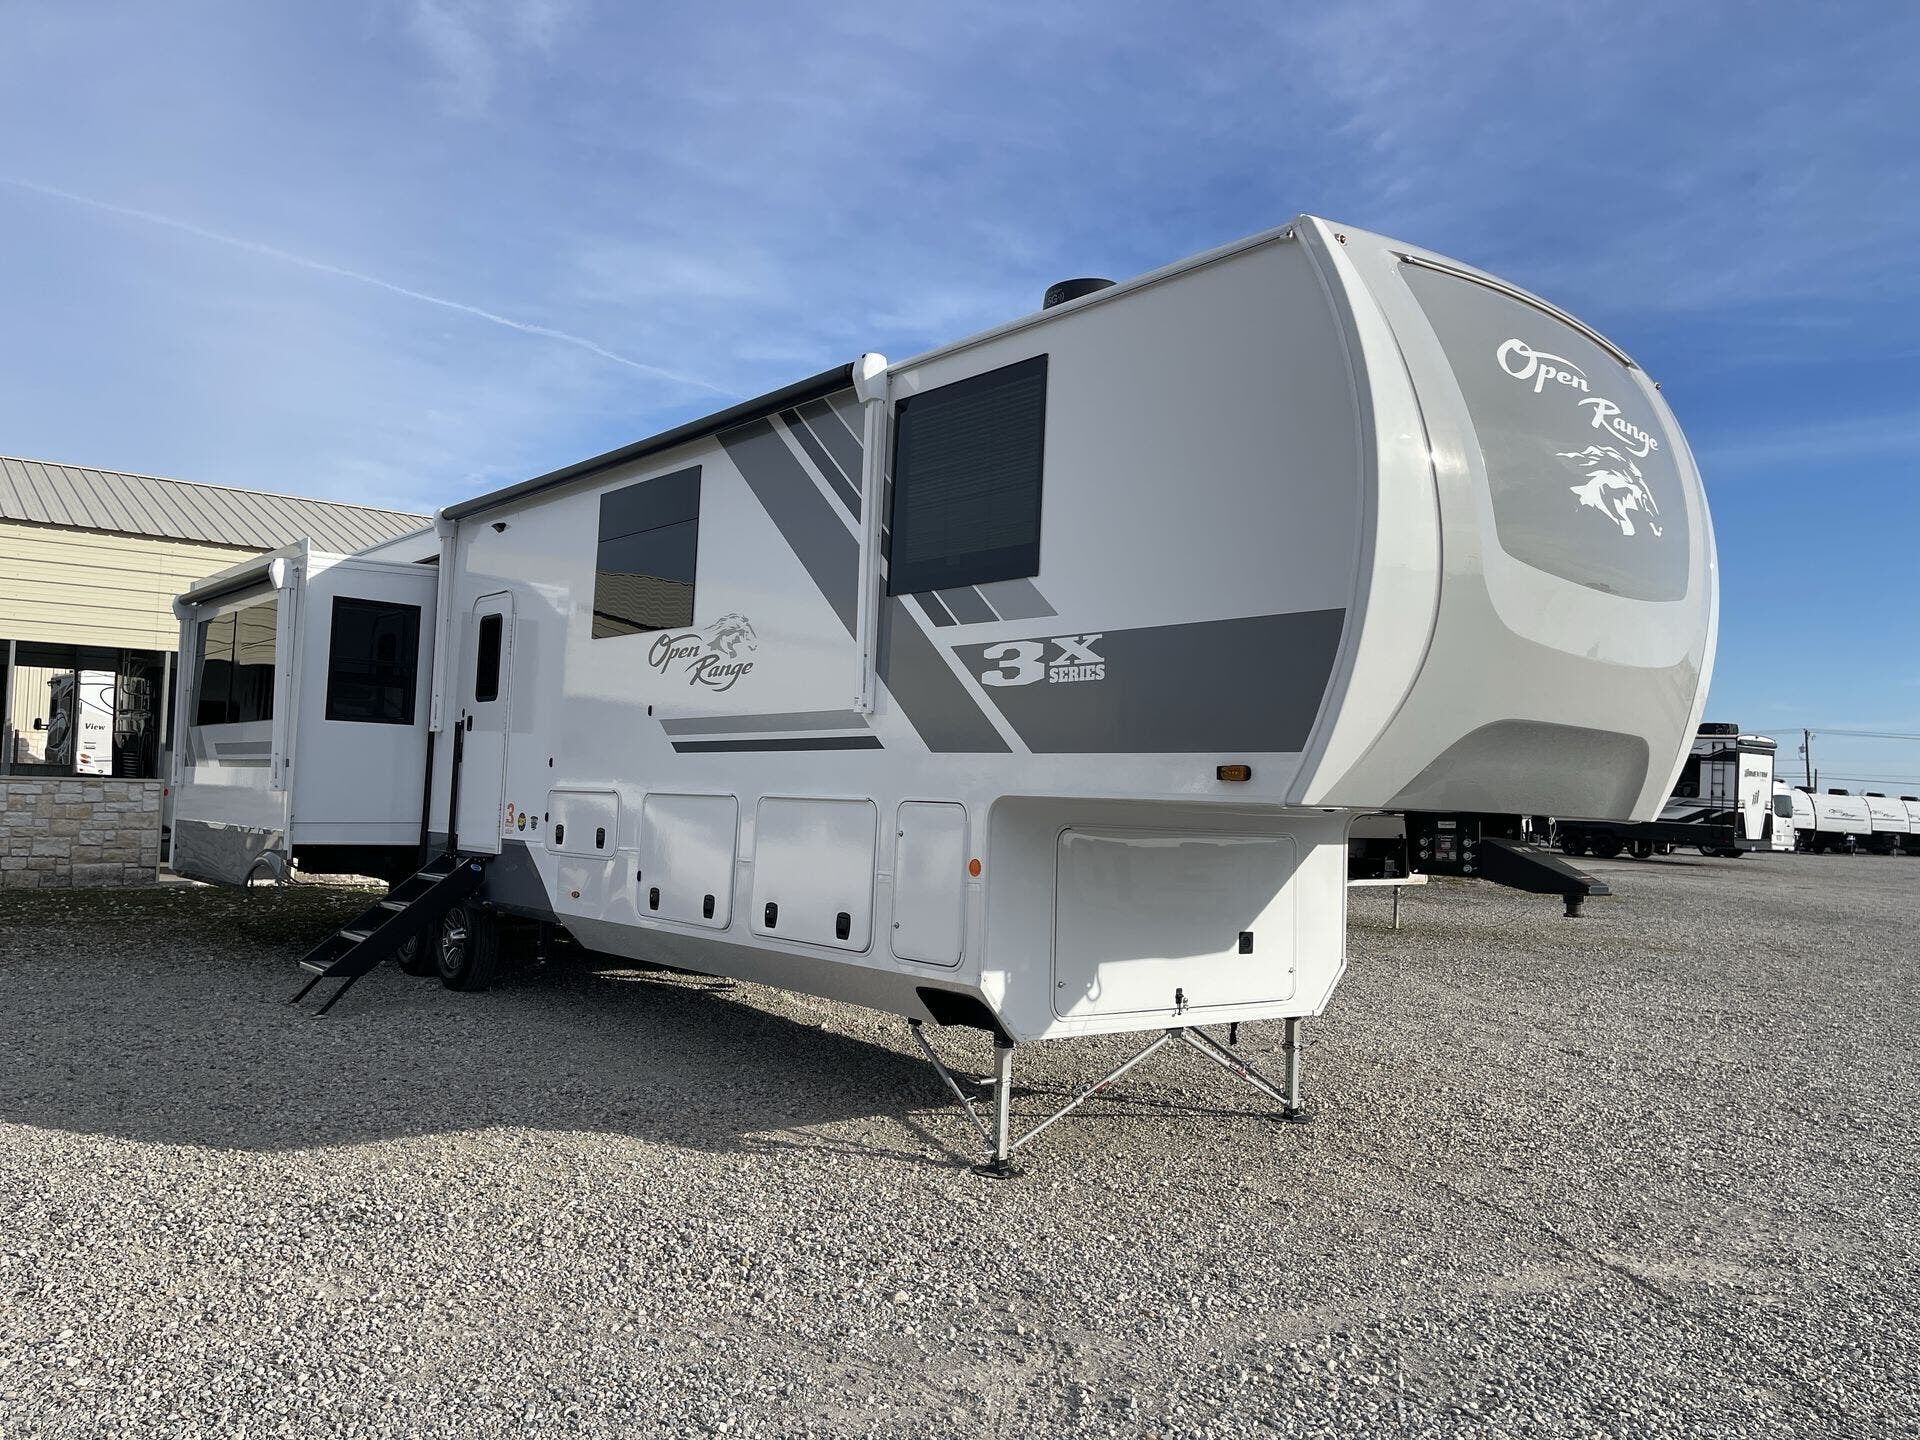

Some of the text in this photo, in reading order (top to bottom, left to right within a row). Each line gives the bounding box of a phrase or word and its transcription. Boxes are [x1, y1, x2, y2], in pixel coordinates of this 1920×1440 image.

[1497, 338, 1591, 393] Open
[1577, 397, 1659, 457] Range
[648, 634, 703, 674] Open
[685, 654, 754, 692] Range
[1049, 664, 1106, 684] SERIES
